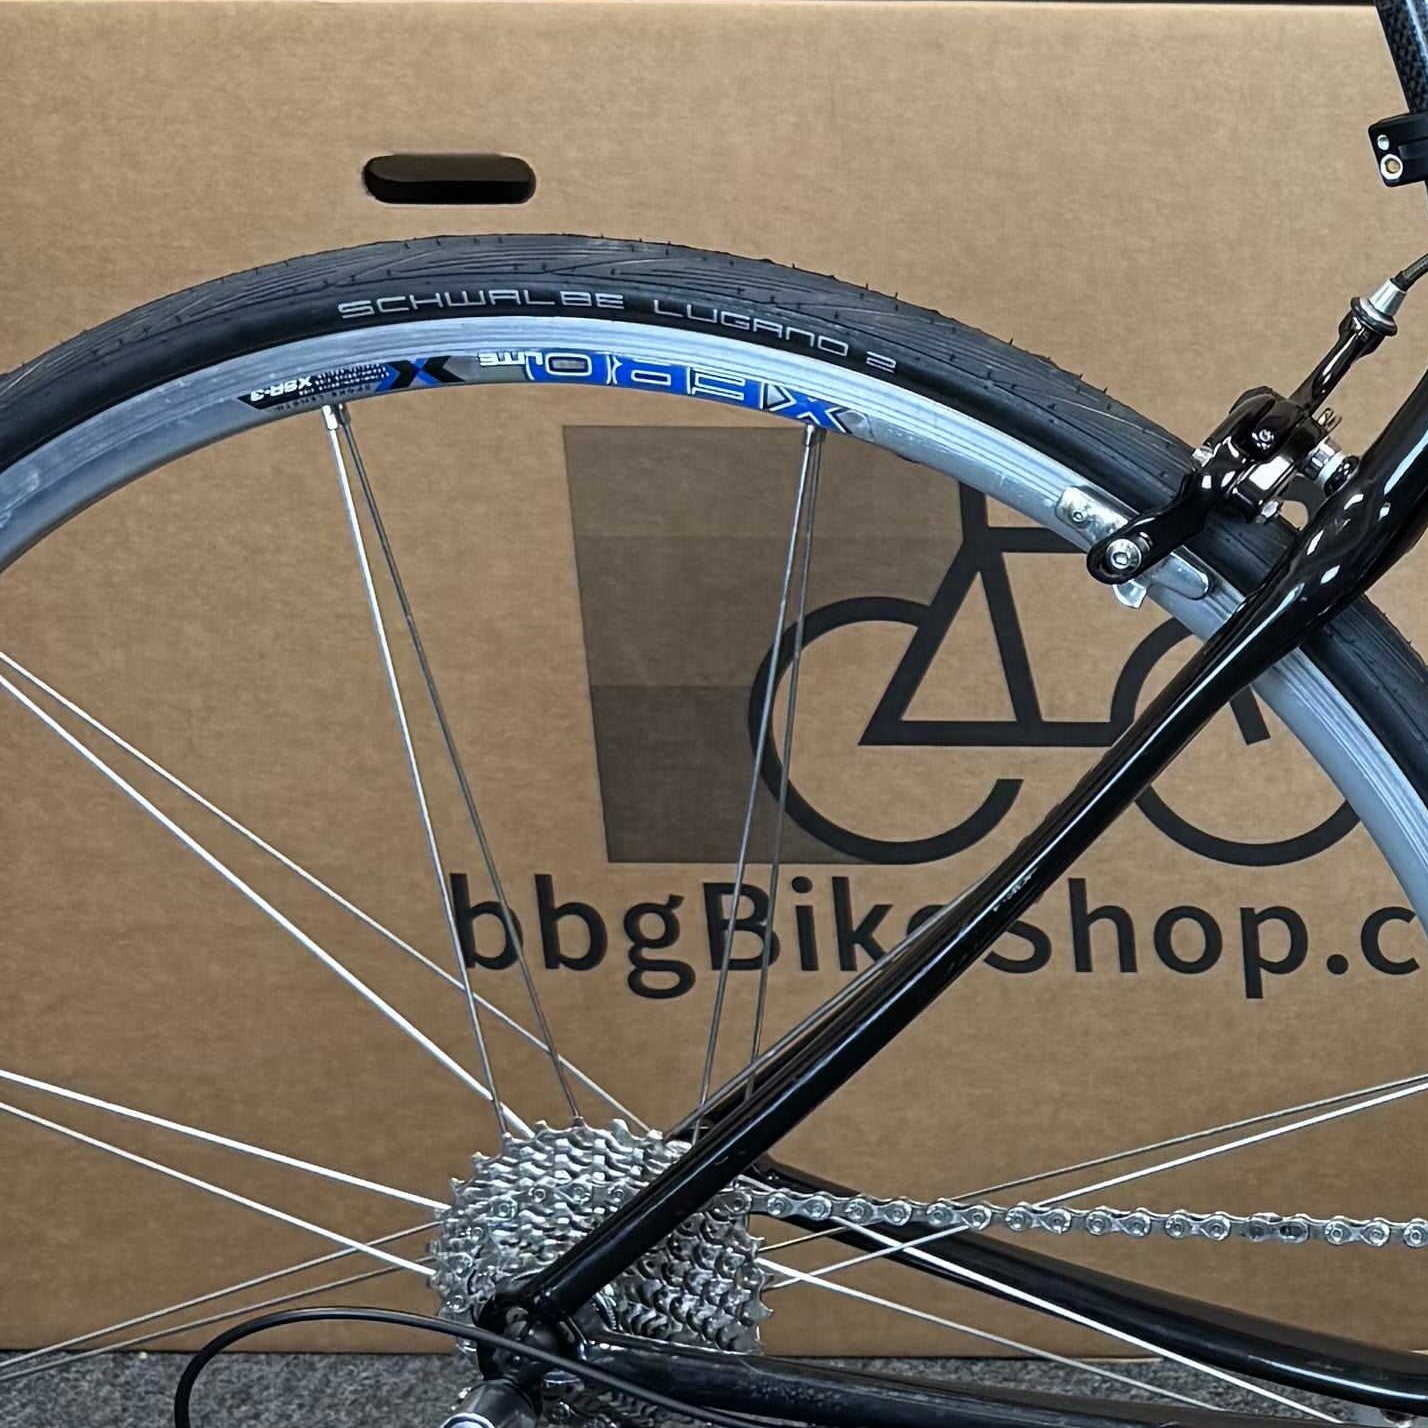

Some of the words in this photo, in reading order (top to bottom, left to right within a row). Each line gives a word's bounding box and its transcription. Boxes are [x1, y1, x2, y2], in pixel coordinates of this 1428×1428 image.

[337, 288, 625, 320] SCHWALBE
[652, 299, 848, 358] LUGANO
[865, 349, 897, 372] 2
[479, 350, 544, 368] LITE
[525, 349, 851, 434] XERO
